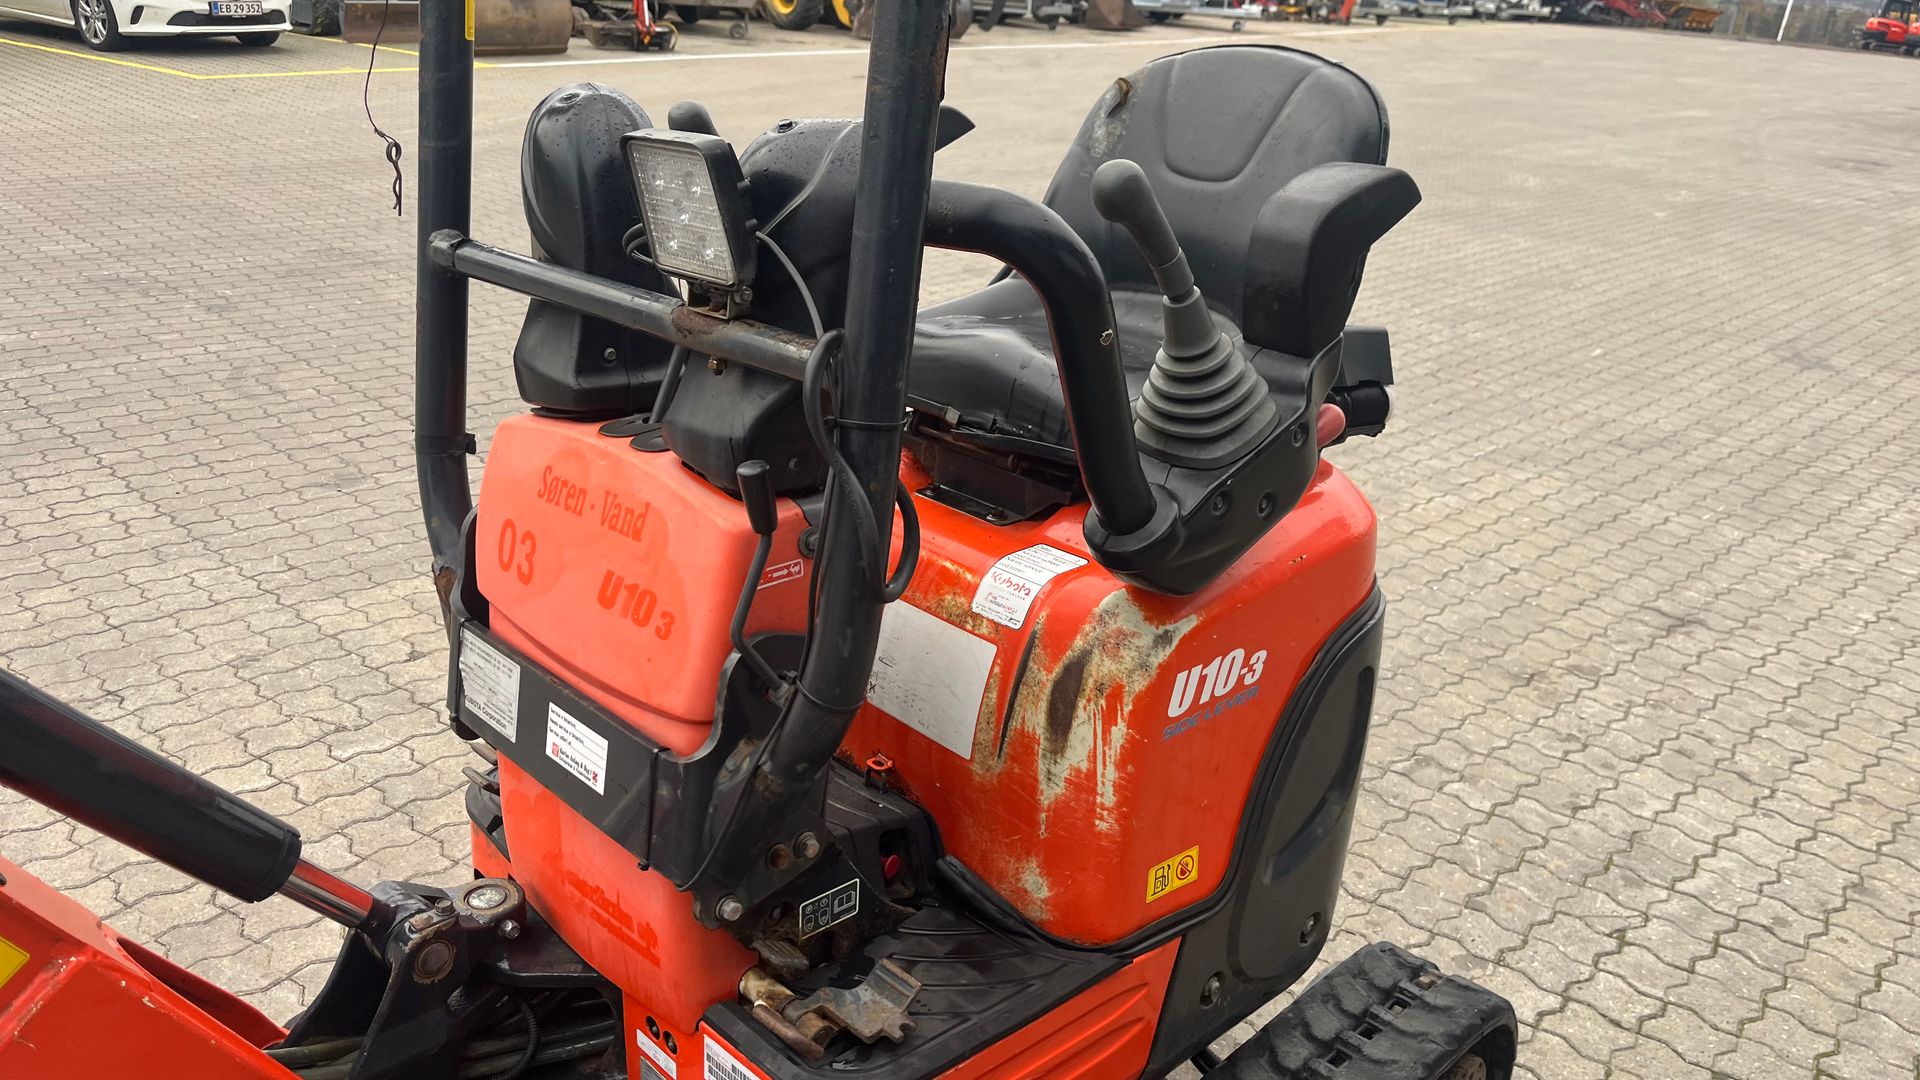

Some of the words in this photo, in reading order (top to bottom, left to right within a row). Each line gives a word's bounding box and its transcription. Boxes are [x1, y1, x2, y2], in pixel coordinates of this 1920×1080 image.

[219, 3, 232, 14] EB
[233, 3, 245, 14] 29
[246, 3, 262, 14] 352
[537, 465, 588, 517] Søren
[600, 490, 651, 542] Vand
[498, 518, 537, 586] 03
[990, 571, 1032, 597] Kubota
[1167, 647, 1268, 718] U10-3
[481, 705, 507, 731] Corporation
[1162, 710, 1202, 742] SIDE
[1203, 685, 1260, 721] LEVER
